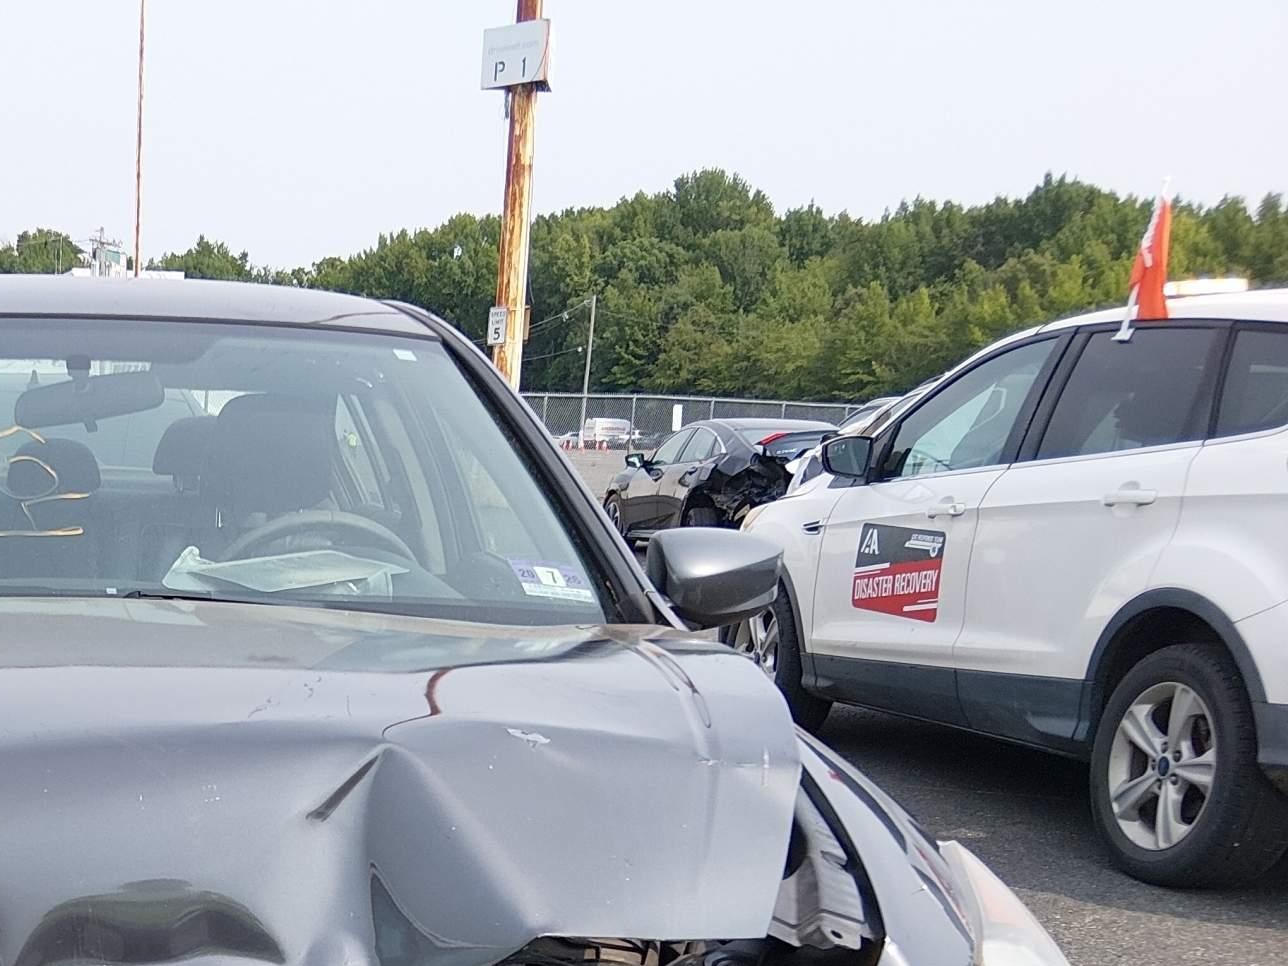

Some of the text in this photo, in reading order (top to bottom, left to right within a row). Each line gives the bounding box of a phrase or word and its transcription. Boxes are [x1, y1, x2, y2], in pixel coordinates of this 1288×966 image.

[493, 60, 506, 82] P
[493, 327, 501, 341] 5
[854, 570, 939, 599] DISASTER RECOVERY
